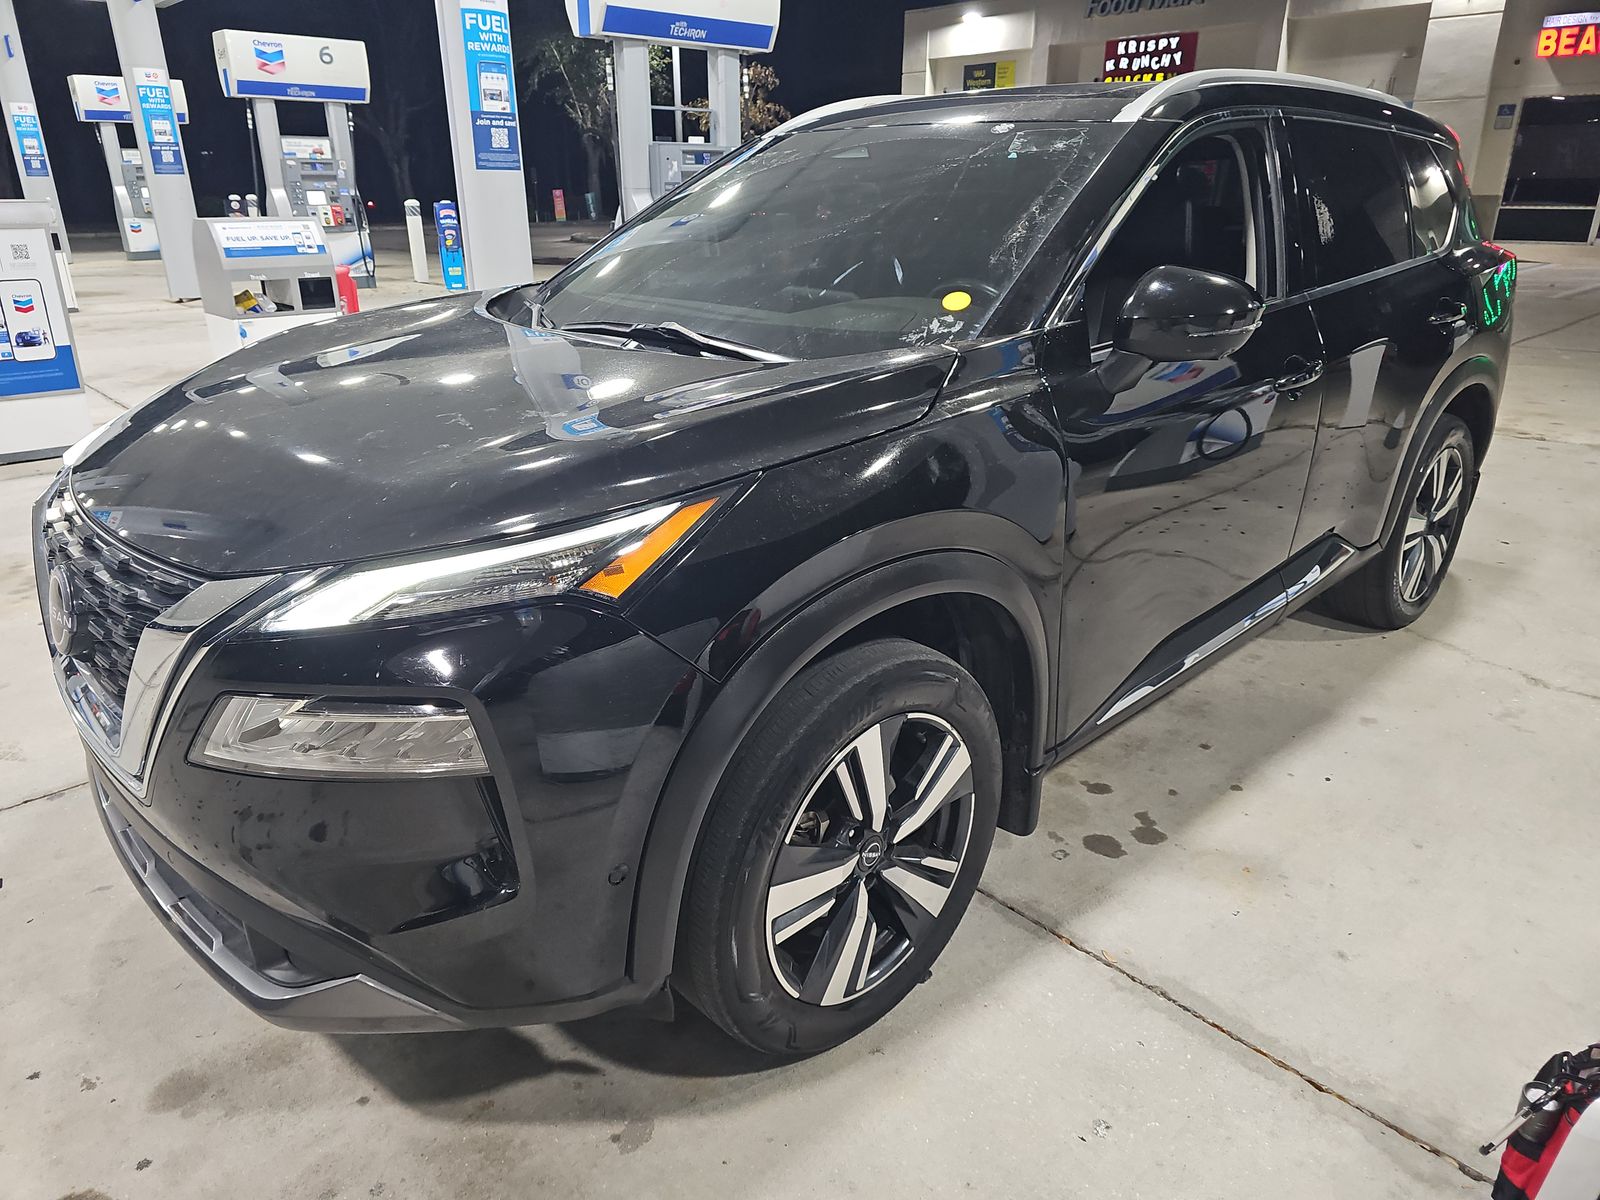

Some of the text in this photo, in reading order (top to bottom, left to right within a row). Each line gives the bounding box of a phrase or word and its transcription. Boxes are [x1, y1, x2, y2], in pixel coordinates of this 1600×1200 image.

[465, 13, 508, 33] FUEL
[479, 32, 503, 43] WITH
[670, 24, 707, 39] TECHRON
[253, 39, 283, 48] Chevron
[1117, 36, 1180, 55] KRISPY
[1536, 24, 1600, 58] BEA
[467, 42, 510, 54] REWARDS
[319, 46, 334, 65] 6
[1105, 51, 1182, 71] KRUNCHY
[139, 88, 169, 98] FUEL
[14, 116, 37, 124] FUEL
[475, 118, 491, 126] Join
